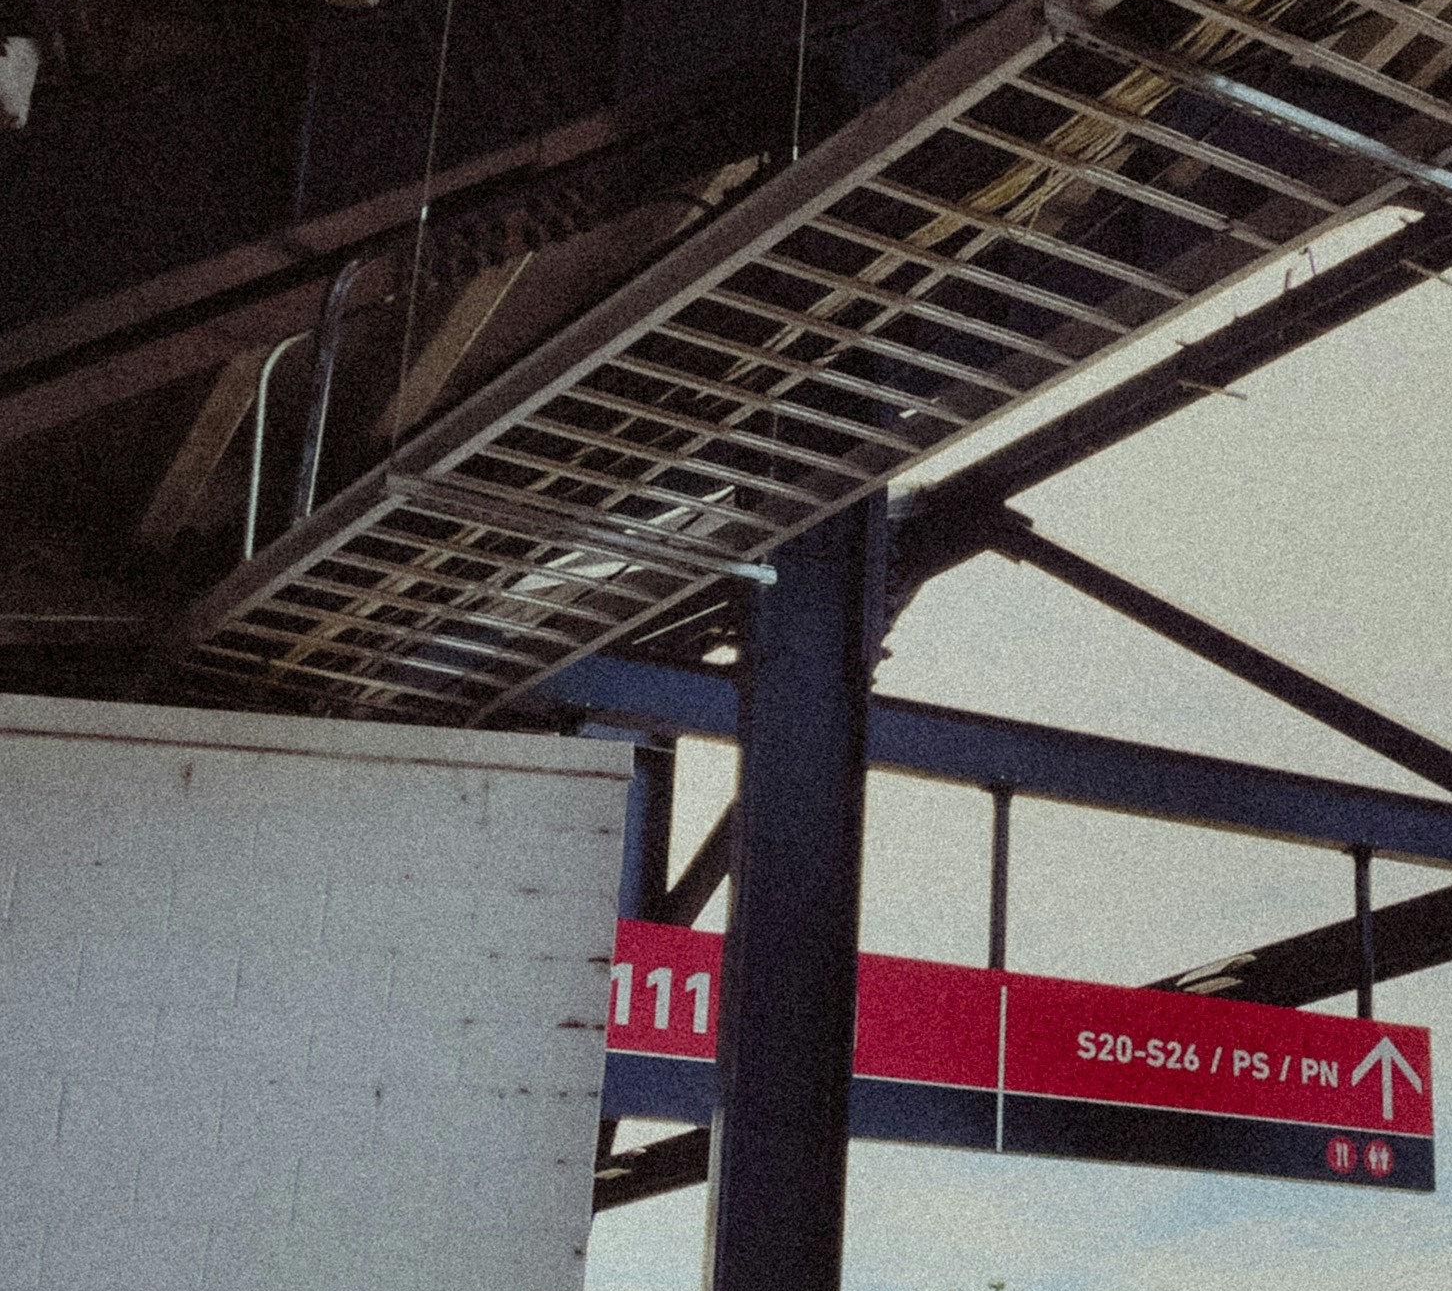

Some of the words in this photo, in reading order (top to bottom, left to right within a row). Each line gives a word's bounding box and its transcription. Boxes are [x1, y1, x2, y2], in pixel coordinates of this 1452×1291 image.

[610, 962, 711, 1034] 111
[1077, 1030, 1200, 1073] S20-S26
[1210, 1046, 1223, 1075] /
[1232, 1049, 1270, 1080] PS
[1279, 1055, 1292, 1083] /
[1301, 1059, 1339, 1088] PN
